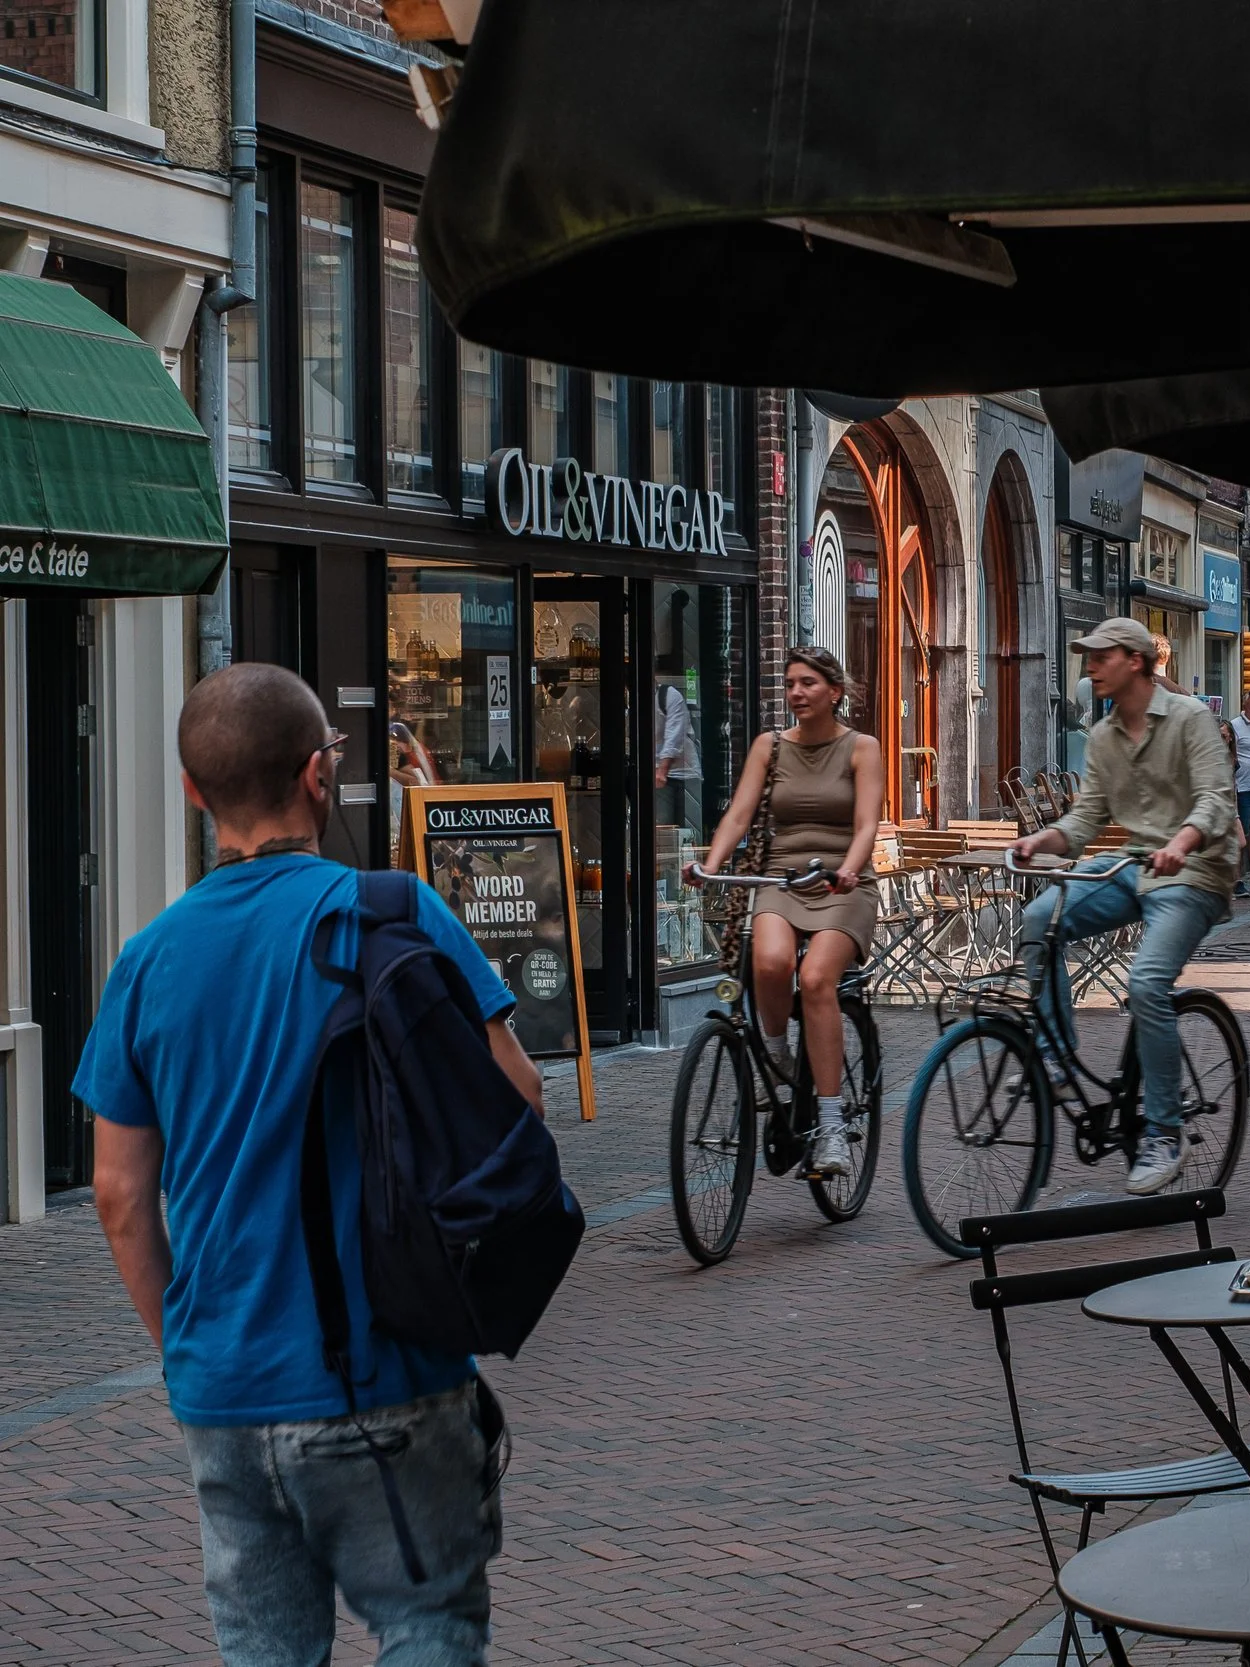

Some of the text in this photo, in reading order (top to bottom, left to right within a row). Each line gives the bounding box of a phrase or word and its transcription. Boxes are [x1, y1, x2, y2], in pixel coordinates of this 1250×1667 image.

[498, 447, 729, 557] OIL&VINEGAR
[48, 541, 89, 577] tate
[490, 675, 508, 707] 25
[428, 807, 552, 828] OIL&VINEGAR
[473, 875, 524, 898] WORD
[464, 900, 537, 924] MEMBER
[473, 928, 533, 940] Altijd de beste deals
[530, 960, 558, 970] QR-CODE
[532, 979, 557, 988] GRATIS
